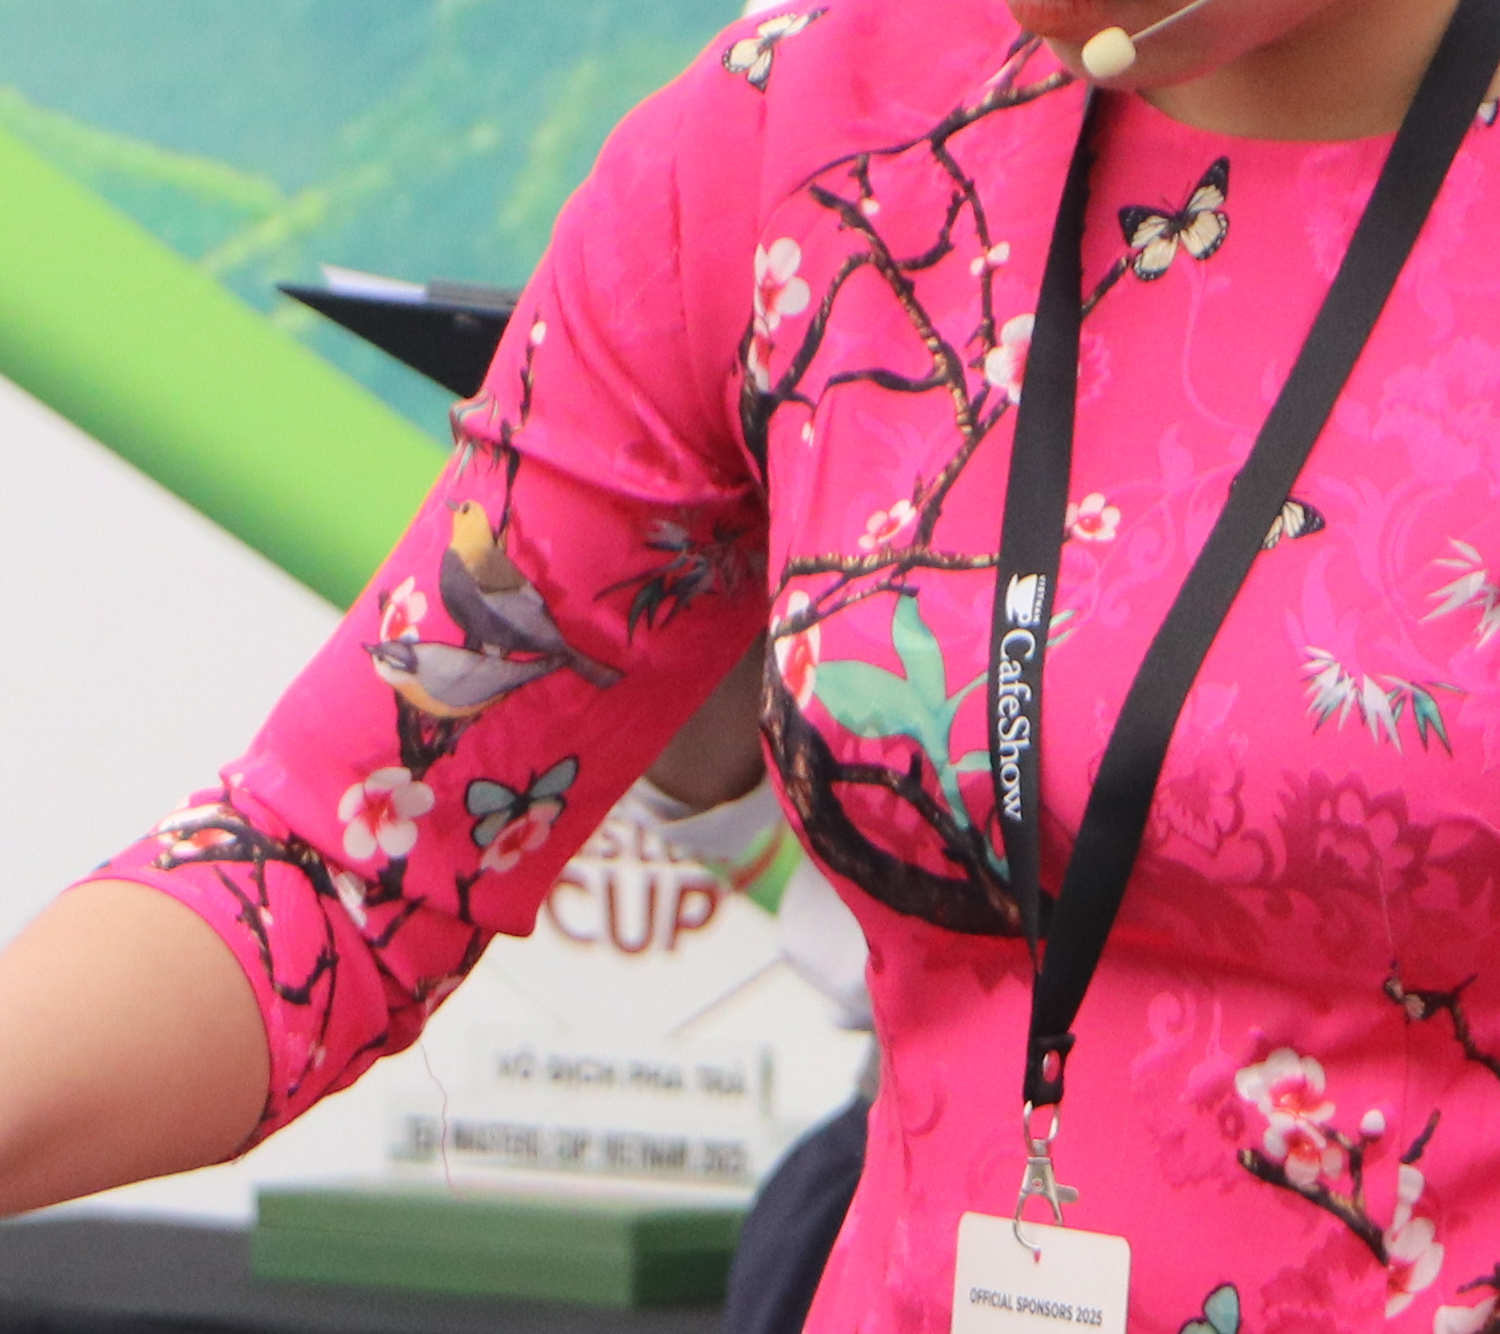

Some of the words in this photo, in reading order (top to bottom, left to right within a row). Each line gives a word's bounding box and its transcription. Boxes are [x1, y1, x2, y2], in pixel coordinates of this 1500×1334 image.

[997, 628, 1037, 822] CafeShow
[548, 865, 722, 954] CUP
[970, 1287, 1013, 1311] OFFICIAL
[1016, 1295, 1073, 1322] SPONSORS
[1075, 1306, 1103, 1326] 2025
